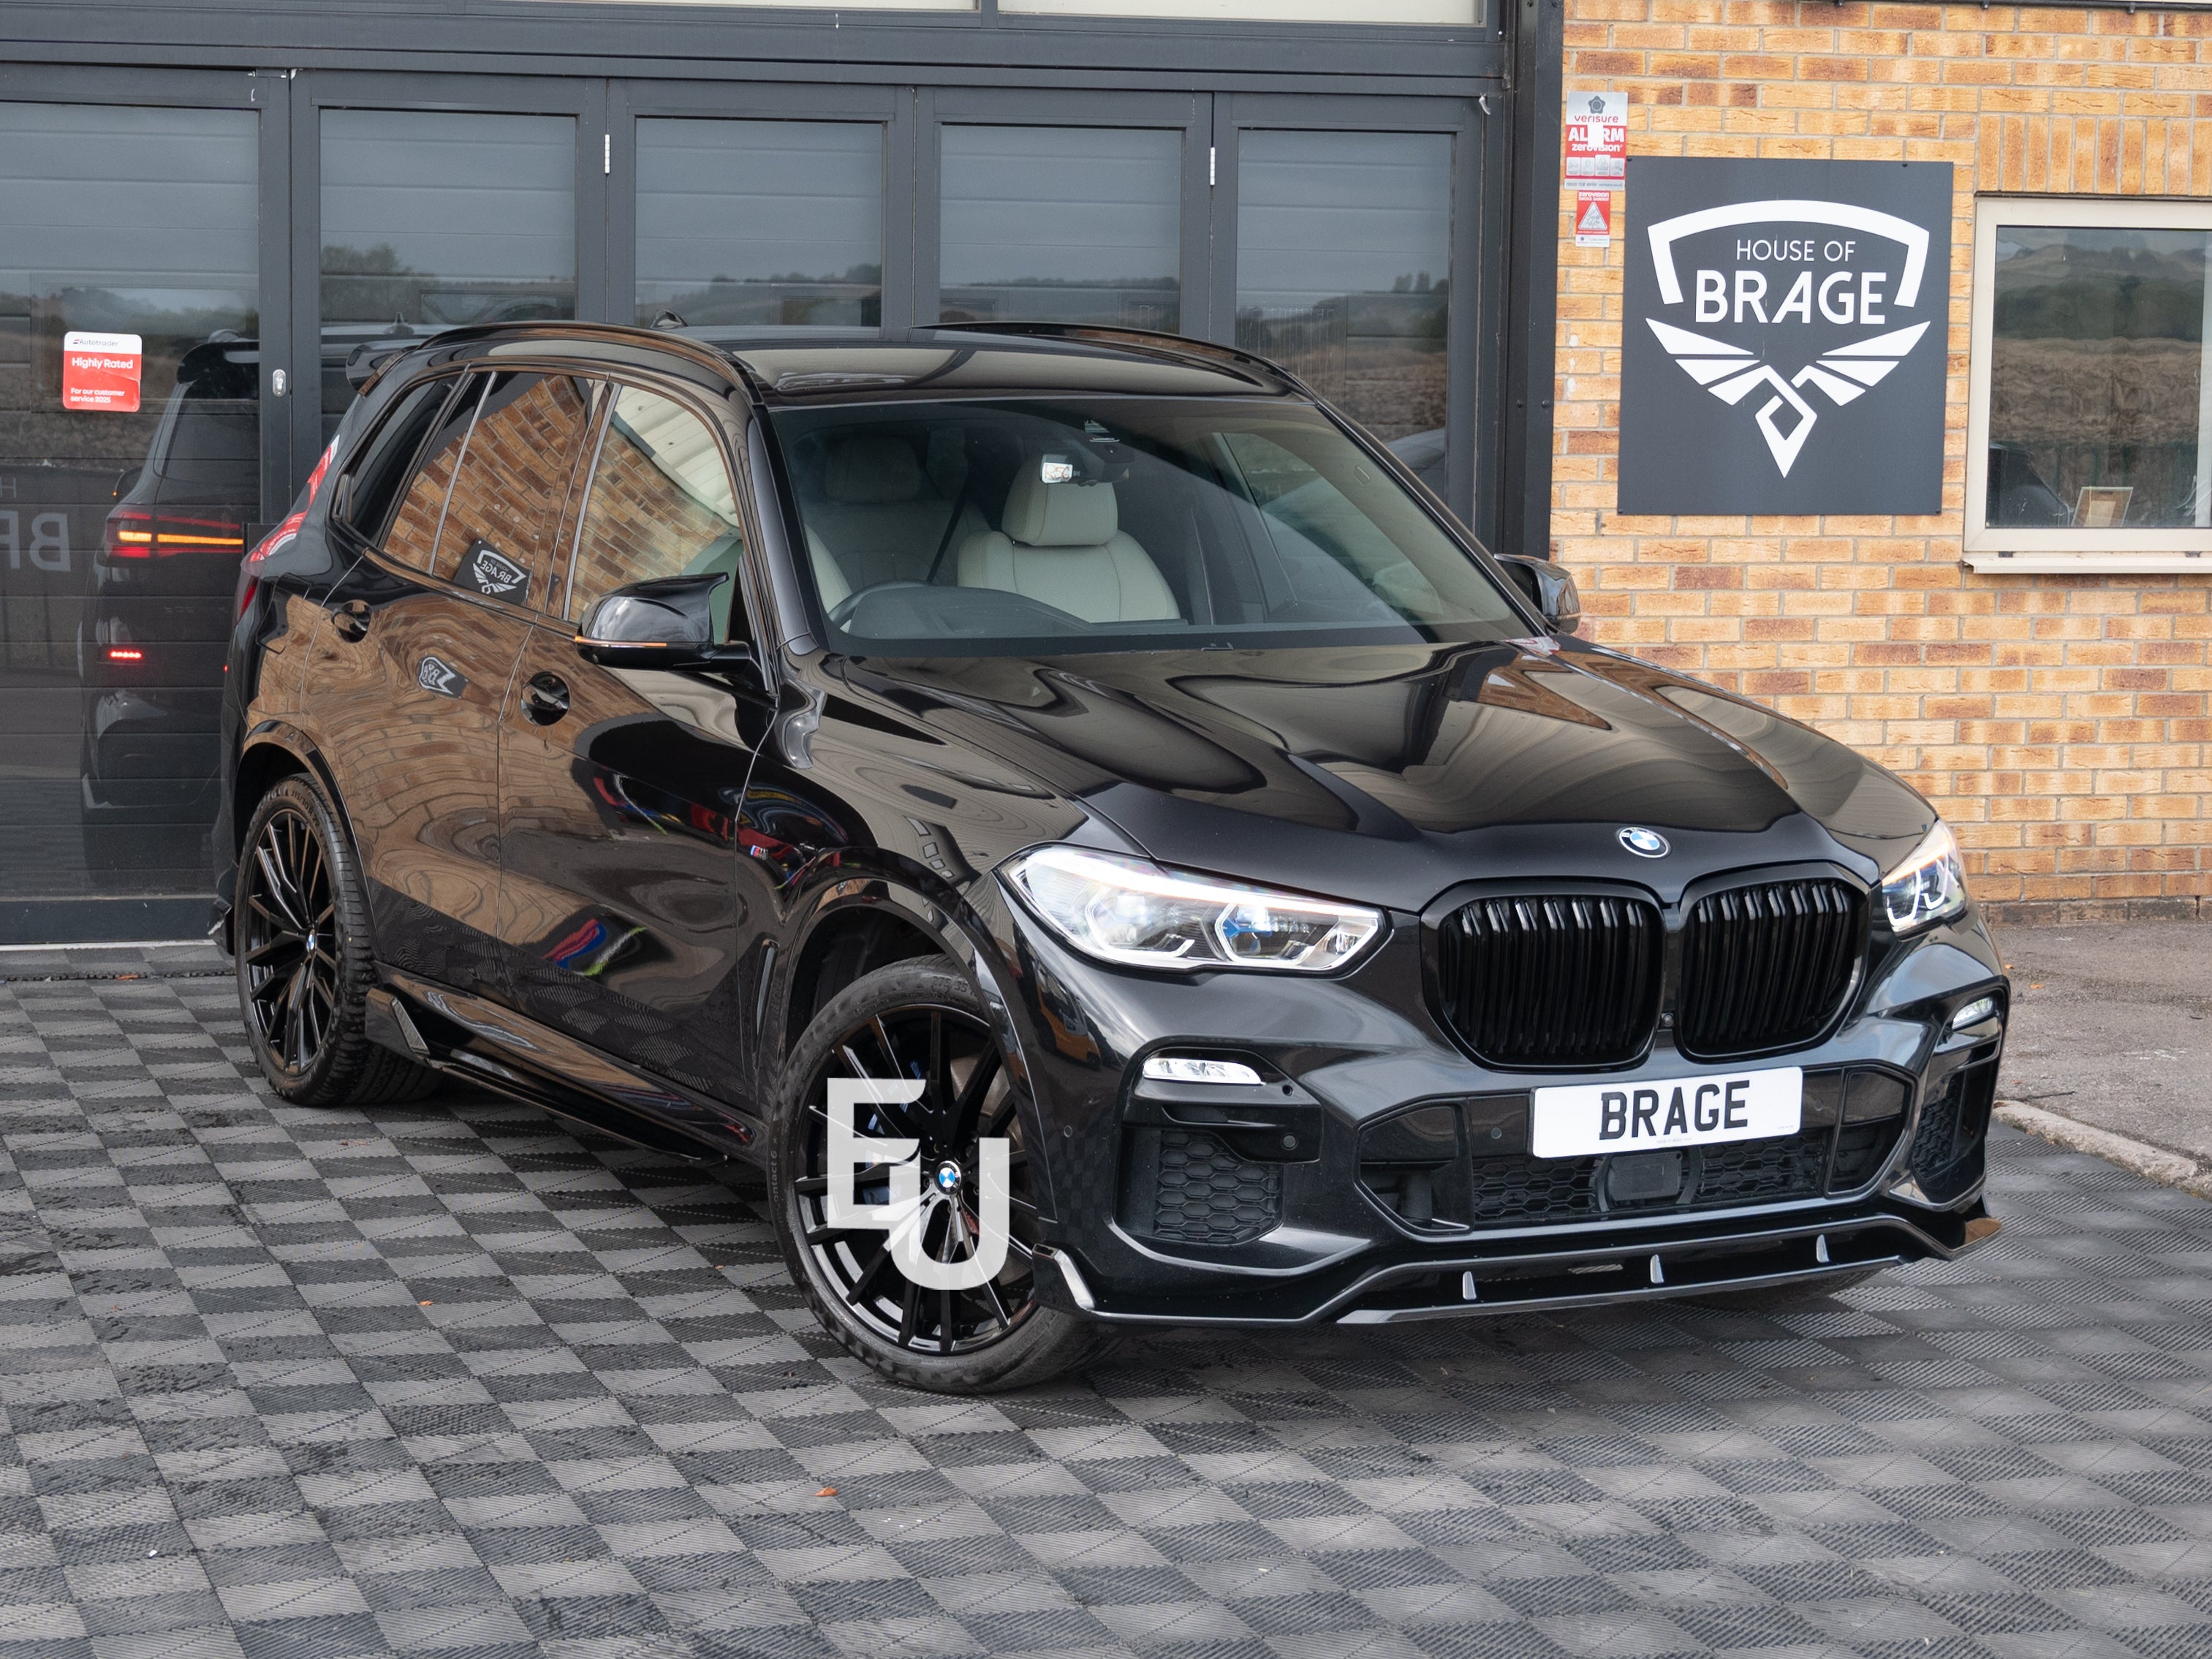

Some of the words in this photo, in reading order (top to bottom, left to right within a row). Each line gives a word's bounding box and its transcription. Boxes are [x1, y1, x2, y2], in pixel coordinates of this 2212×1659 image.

[1574, 115, 1618, 123] verisure
[1568, 126, 1624, 143] ALRM
[1736, 239, 1814, 262] HOUSE
[1824, 240, 1855, 262] OF
[1695, 269, 1887, 325] BRAGE
[79, 339, 118, 347] Autotrader
[72, 357, 102, 369] Highly
[104, 359, 133, 369] Rated
[1599, 1080, 1750, 1141] BRAGE
